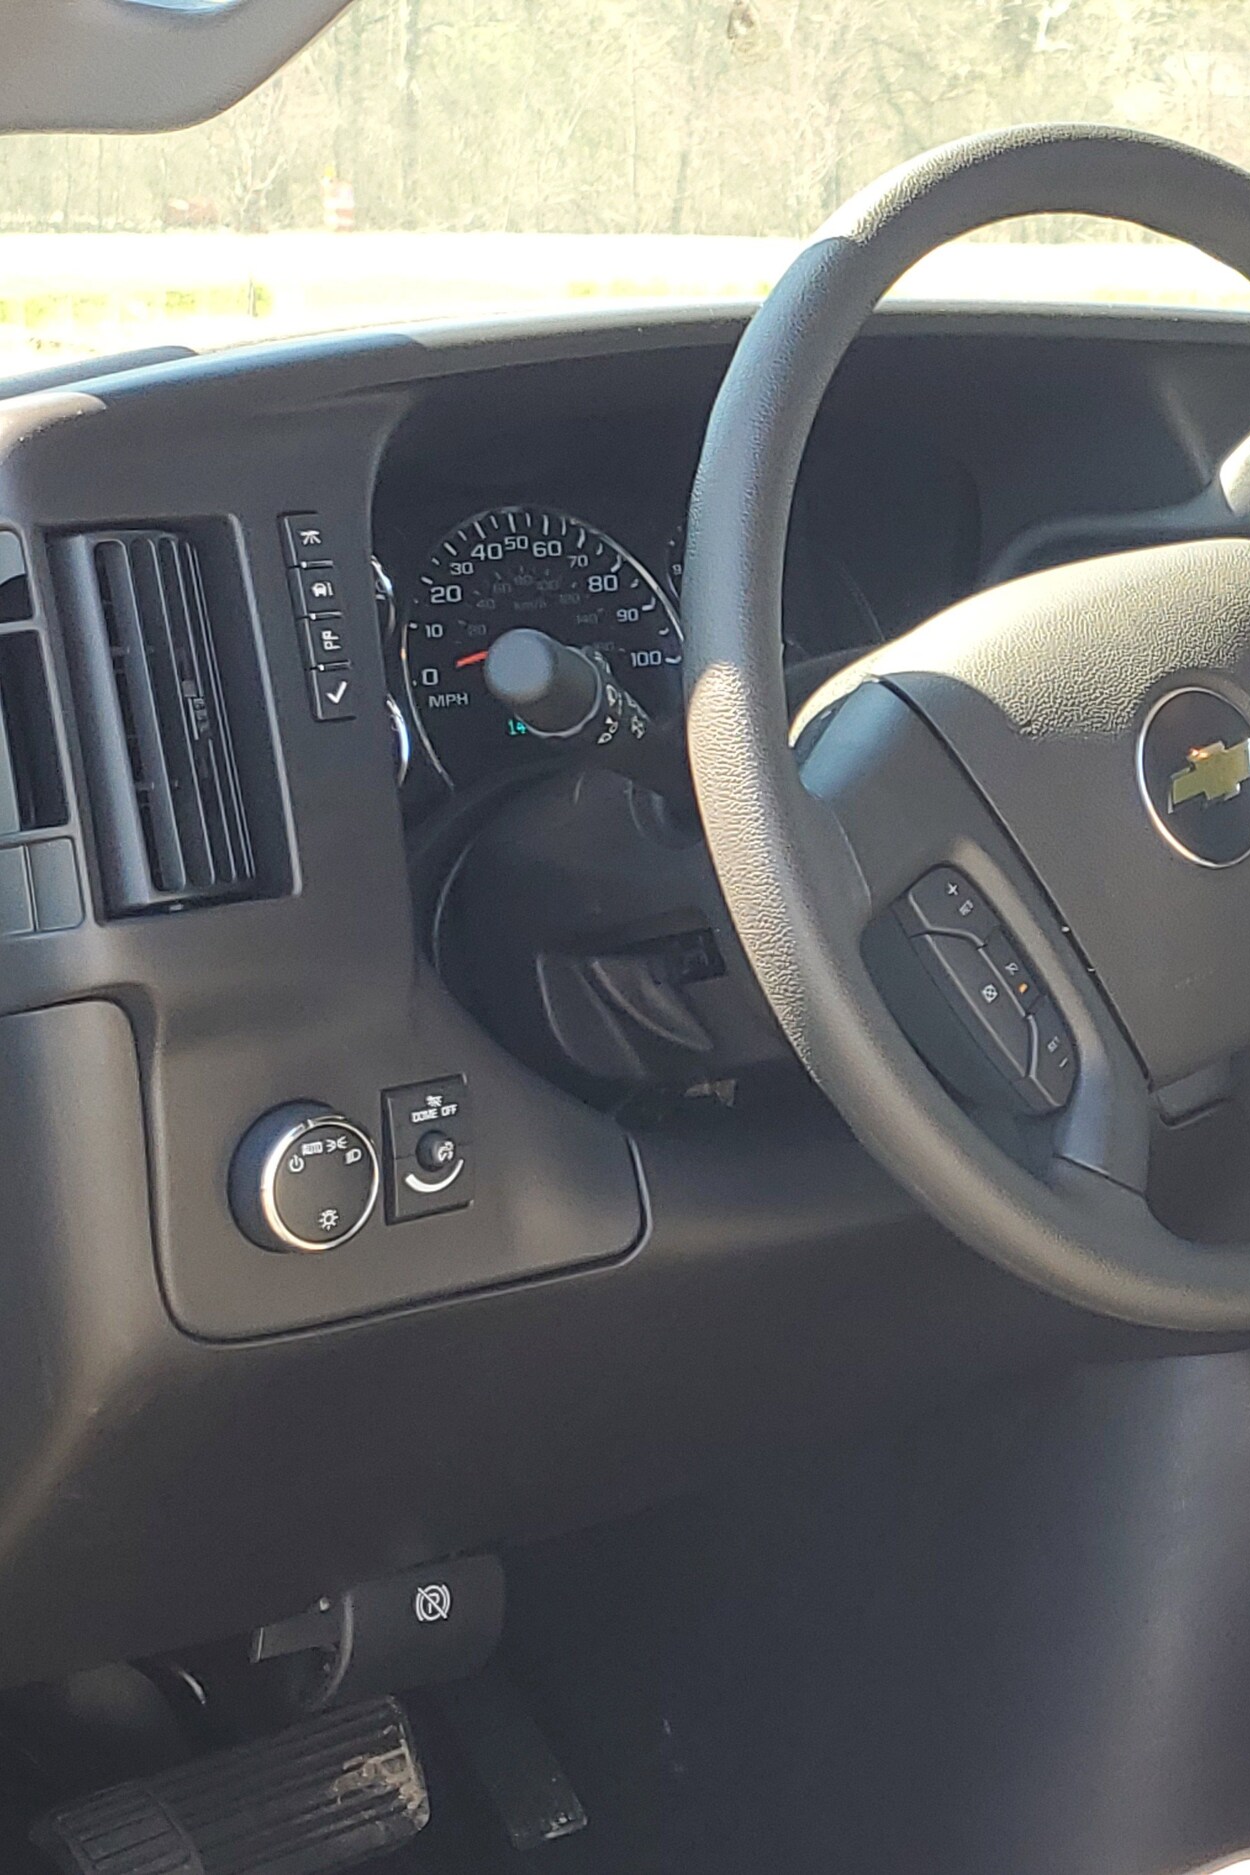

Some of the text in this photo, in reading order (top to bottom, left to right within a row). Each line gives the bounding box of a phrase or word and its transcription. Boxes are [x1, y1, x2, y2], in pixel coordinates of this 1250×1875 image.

[504, 536, 528, 549] 50
[532, 541, 562, 557] 60
[470, 543, 503, 560] 40
[450, 562, 474, 575] 30
[567, 555, 589, 568] 70
[587, 575, 618, 592] 80
[430, 585, 462, 603] 20
[616, 609, 639, 622] 90
[425, 624, 443, 638] 10
[630, 651, 662, 667] 100
[422, 668, 439, 686] 0
[428, 692, 469, 708] MPH
[411, 1104, 458, 1123] DOME OFF
